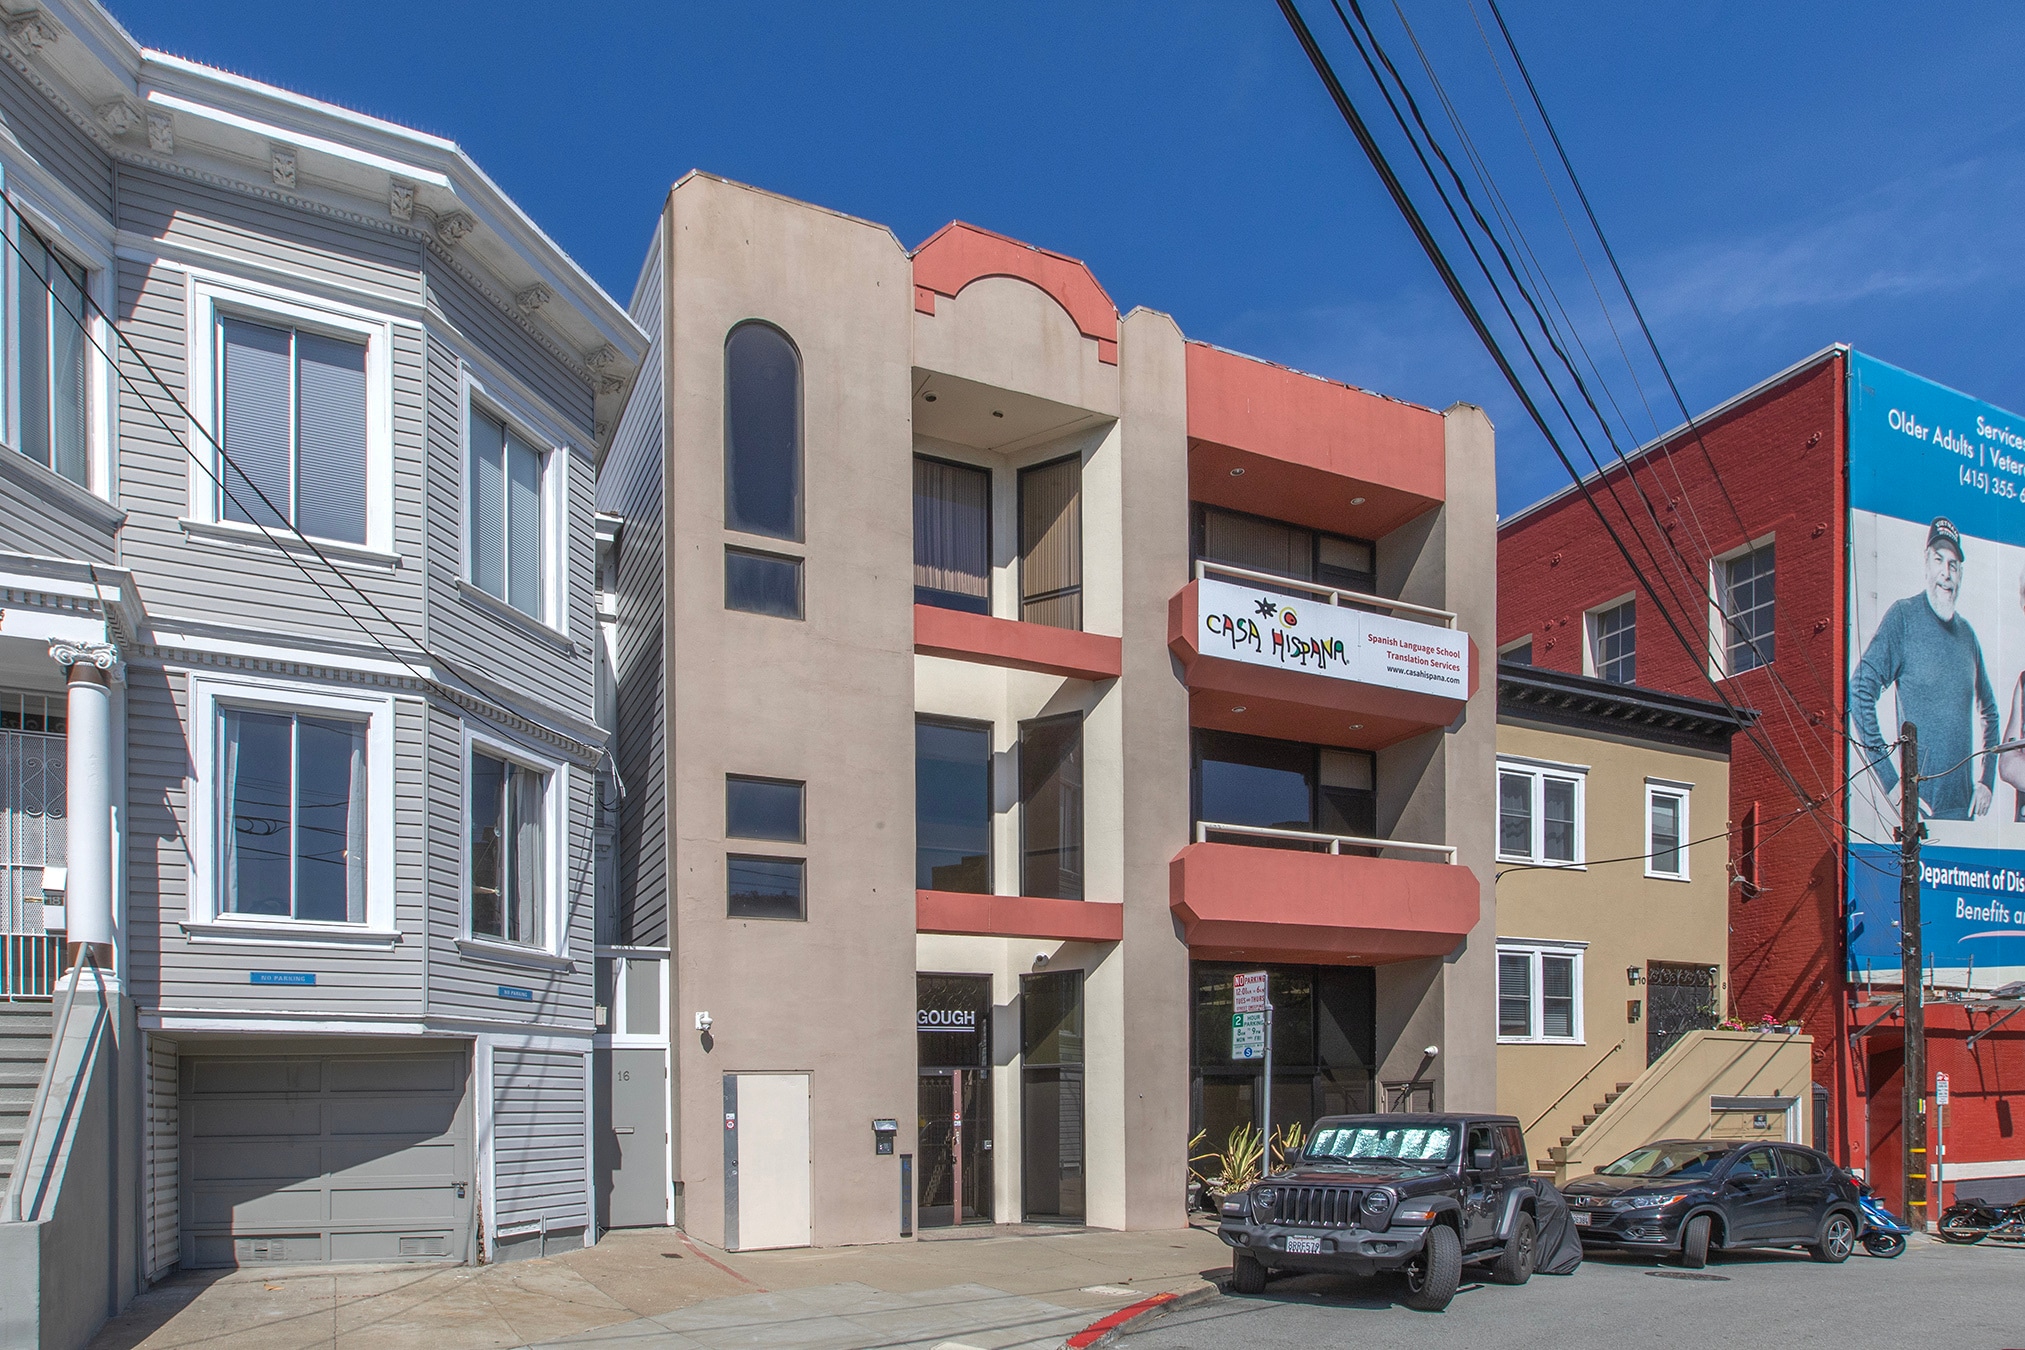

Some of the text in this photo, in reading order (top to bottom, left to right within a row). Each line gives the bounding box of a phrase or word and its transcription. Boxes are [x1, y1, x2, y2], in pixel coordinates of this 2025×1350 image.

[1888, 408, 1929, 441] Older
[1932, 426, 1974, 459] Adults
[1960, 464, 1988, 495] (415)
[1206, 613, 1348, 670] CASA HISPANA
[1368, 633, 1460, 659] Spanish Language School
[1386, 650, 1460, 672] Translation Services
[1386, 665, 1460, 684] www.casahispana.com
[1992, 869, 2005, 891] of
[1956, 897, 2009, 923] Benefits
[1235, 974, 1266, 986] NO PARKING
[1638, 976, 1647, 985] 10
[917, 1009, 975, 1025] GOUGH
[1235, 1015, 1242, 1026] 2
[617, 1070, 630, 1082] 16
